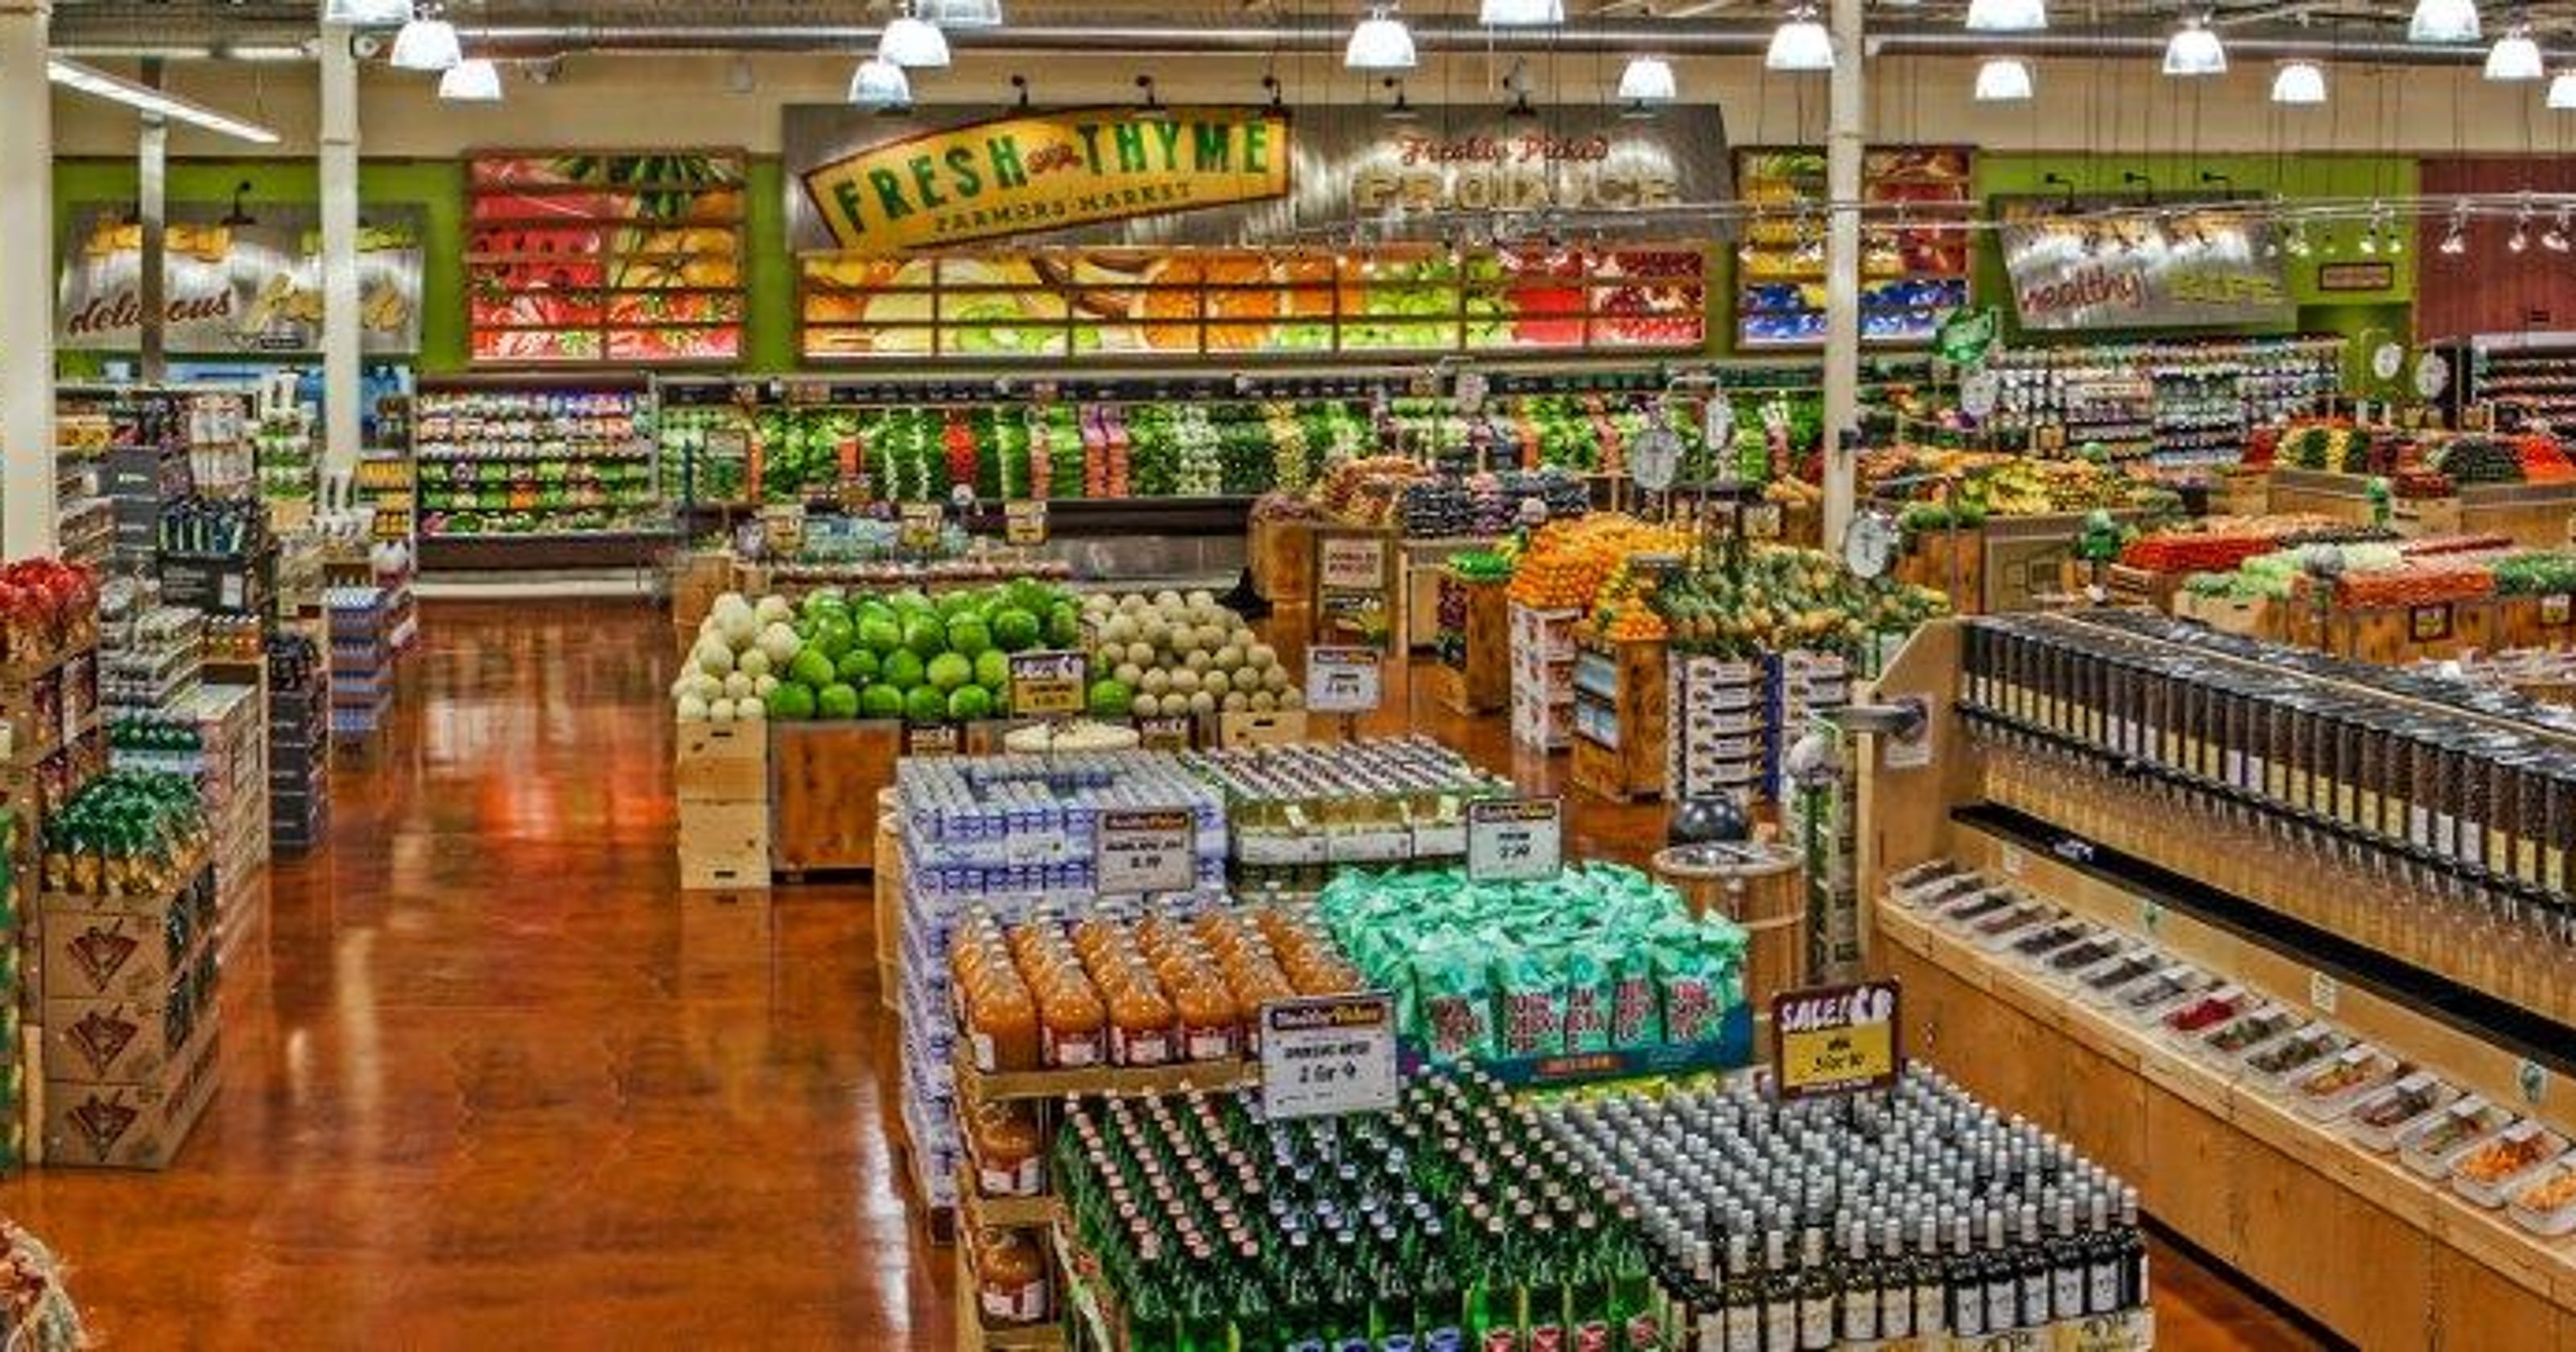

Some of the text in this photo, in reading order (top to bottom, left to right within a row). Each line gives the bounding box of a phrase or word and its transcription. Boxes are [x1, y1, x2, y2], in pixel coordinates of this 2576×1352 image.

[832, 134, 1028, 235] FRESH
[1076, 121, 1269, 175] THYME
[936, 181, 1192, 233] FARMERS MARKET
[67, 288, 233, 336] delious
[2021, 266, 2143, 314] healthy
